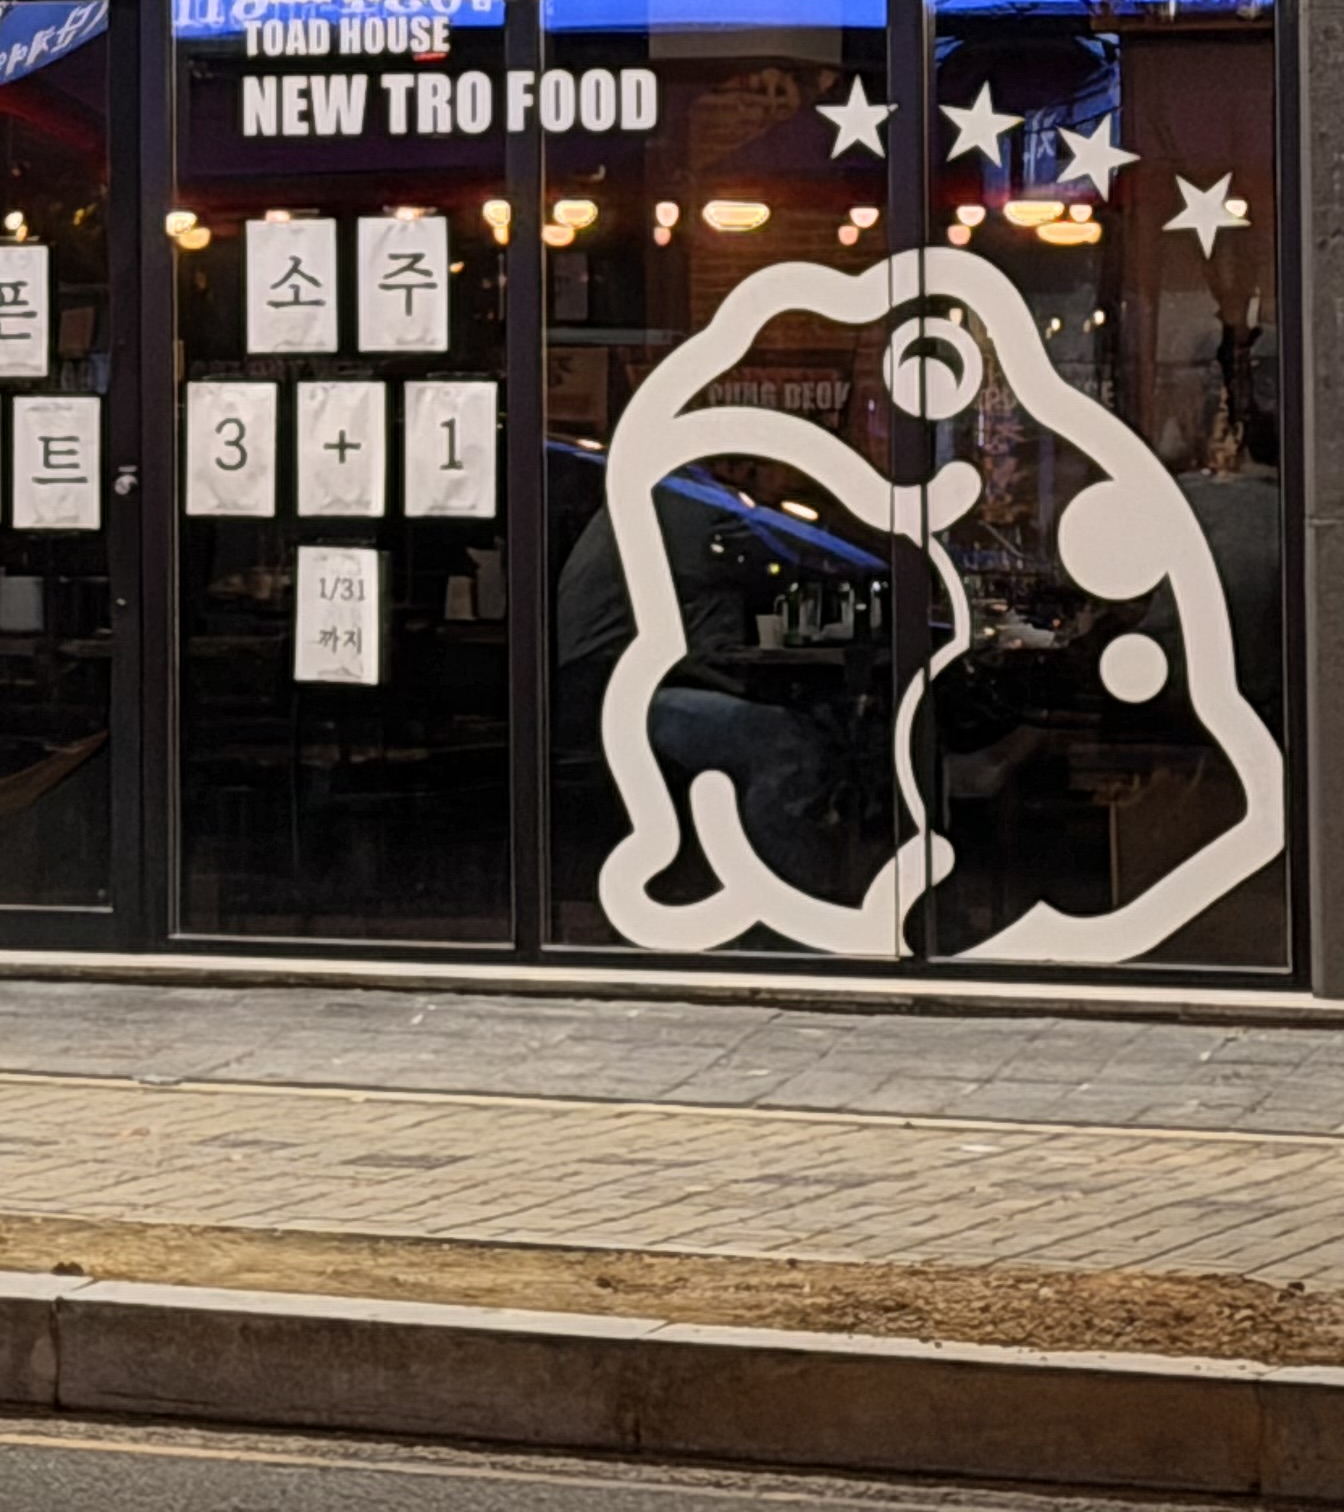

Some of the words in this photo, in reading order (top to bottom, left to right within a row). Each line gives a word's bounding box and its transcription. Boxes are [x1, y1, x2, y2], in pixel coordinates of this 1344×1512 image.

[244, 18, 330, 58] TOAD
[339, 15, 451, 55] HOUSE
[242, 75, 368, 137] NEW
[380, 70, 493, 136] TRO
[505, 67, 658, 133] FOOD
[265, 252, 439, 318] 소주
[318, 577, 366, 602] 1/31
[317, 625, 363, 656] 까지
